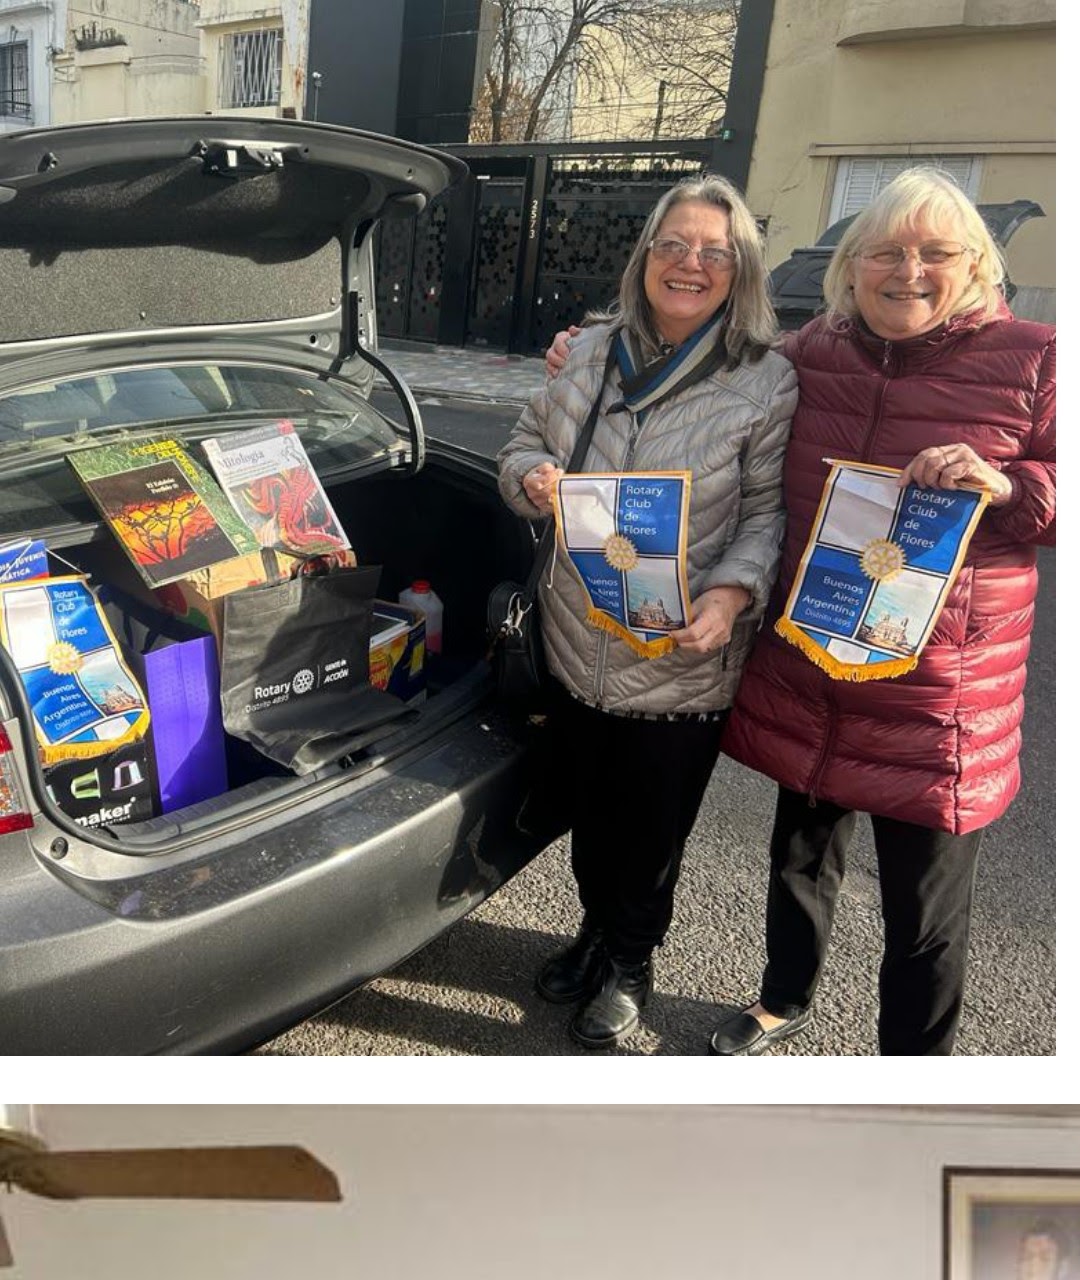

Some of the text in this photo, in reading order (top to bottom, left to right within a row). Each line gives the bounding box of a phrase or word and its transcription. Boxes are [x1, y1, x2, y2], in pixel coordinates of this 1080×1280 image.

[529, 199, 539, 239] 2573
[626, 485, 664, 497] Rotary
[912, 489, 955, 508] Rotary
[625, 499, 651, 509] Club
[908, 504, 938, 519] Club
[624, 512, 639, 521] de
[623, 525, 656, 536] Flores
[904, 519, 920, 531] de
[900, 532, 935, 549] Flores
[823, 575, 864, 595] Buenos
[53, 589, 79, 600] Rotary
[832, 591, 860, 606] Aires
[56, 602, 76, 613] Club
[803, 595, 856, 618] Argentina
[59, 617, 70, 627] de
[805, 607, 832, 624] Distrito
[61, 626, 87, 639] Flores
[43, 683, 76, 699] Buenos
[60, 692, 81, 704] Aires
[255, 682, 291, 700] Rotary
[43, 700, 87, 724] Argentina
